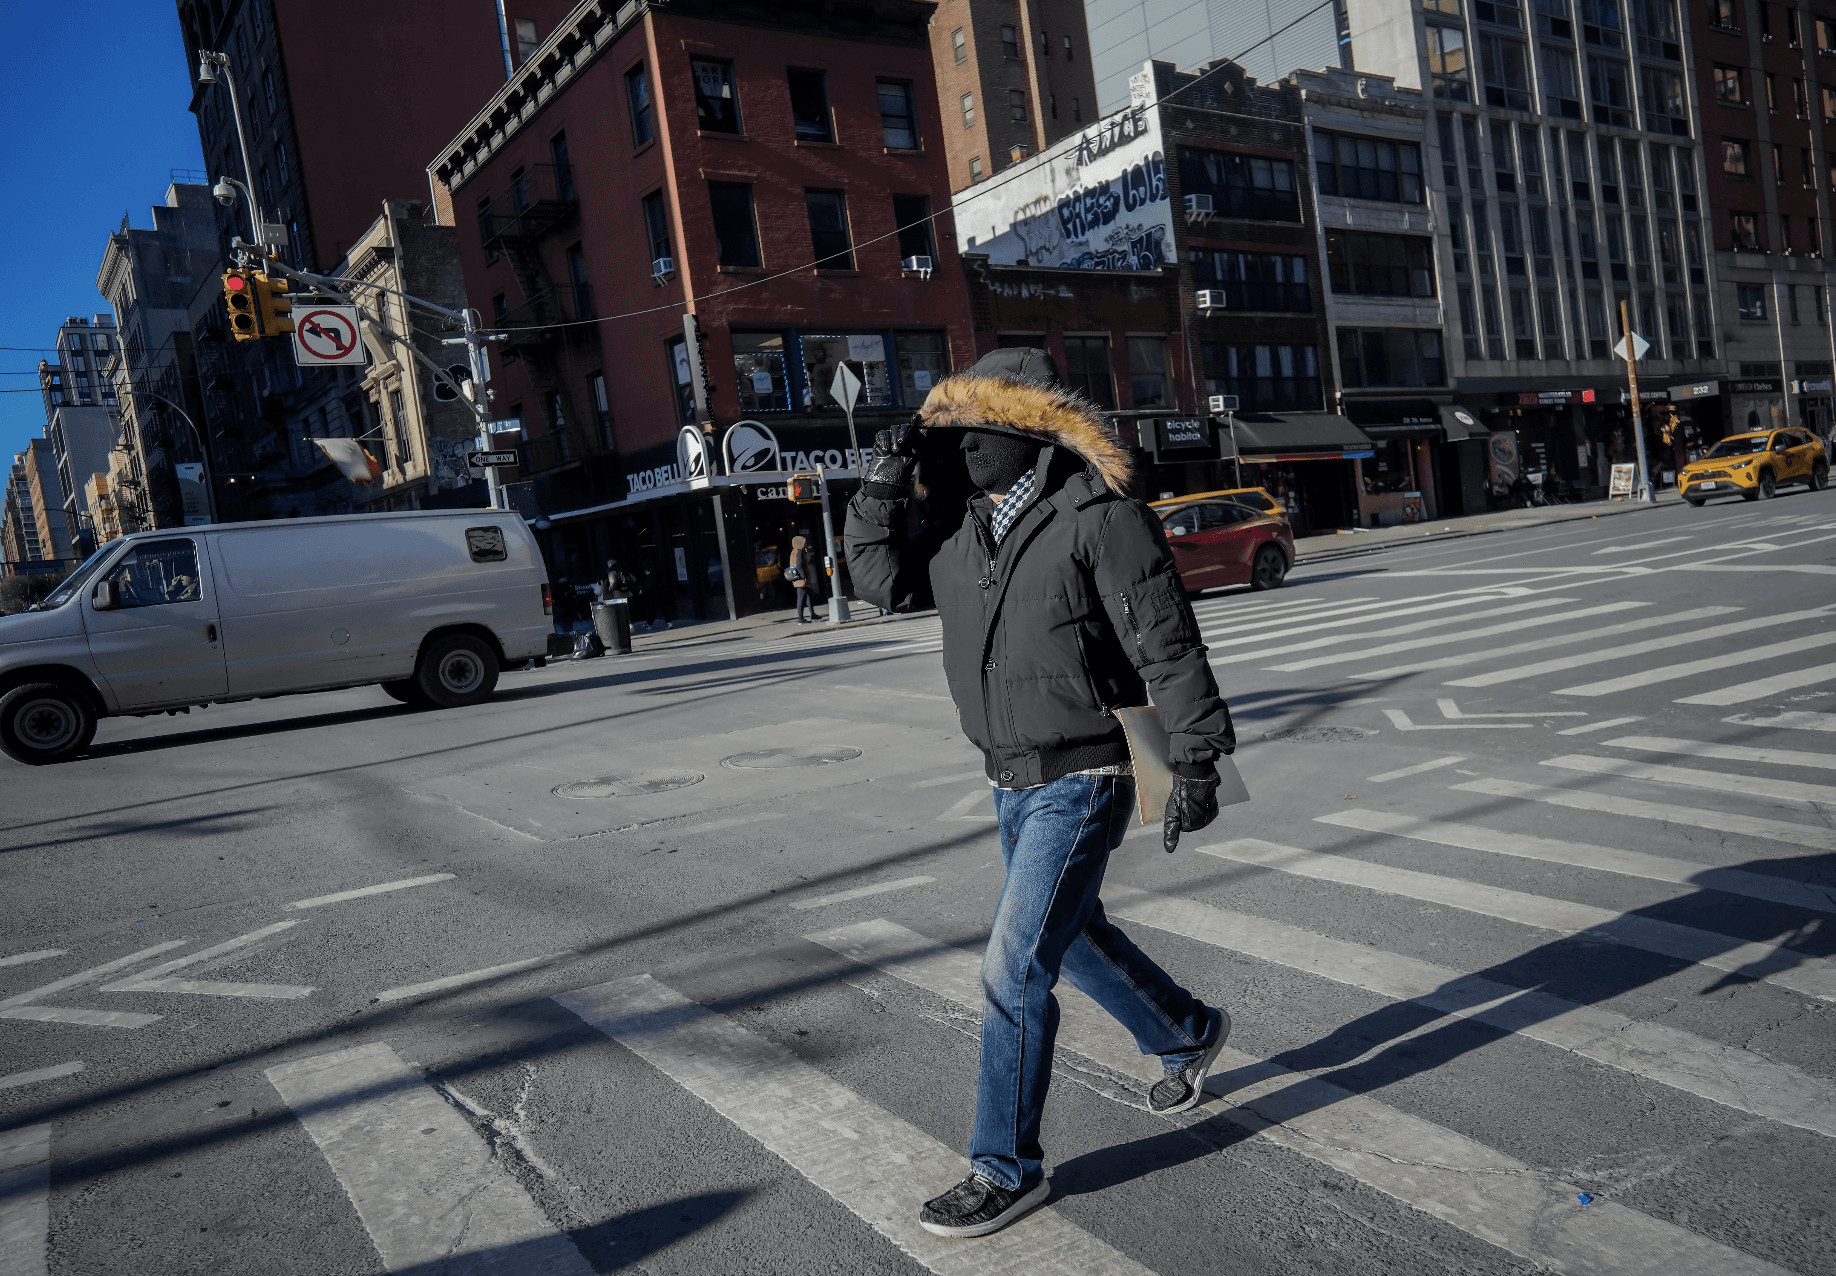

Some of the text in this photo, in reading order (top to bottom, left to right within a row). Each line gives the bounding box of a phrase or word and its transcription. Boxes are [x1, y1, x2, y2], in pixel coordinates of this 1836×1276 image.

[1693, 385, 1709, 395] 232
[1166, 419, 1201, 430] bicycle
[780, 447, 875, 471] TACO BE
[627, 463, 682, 493] TACO BELL
